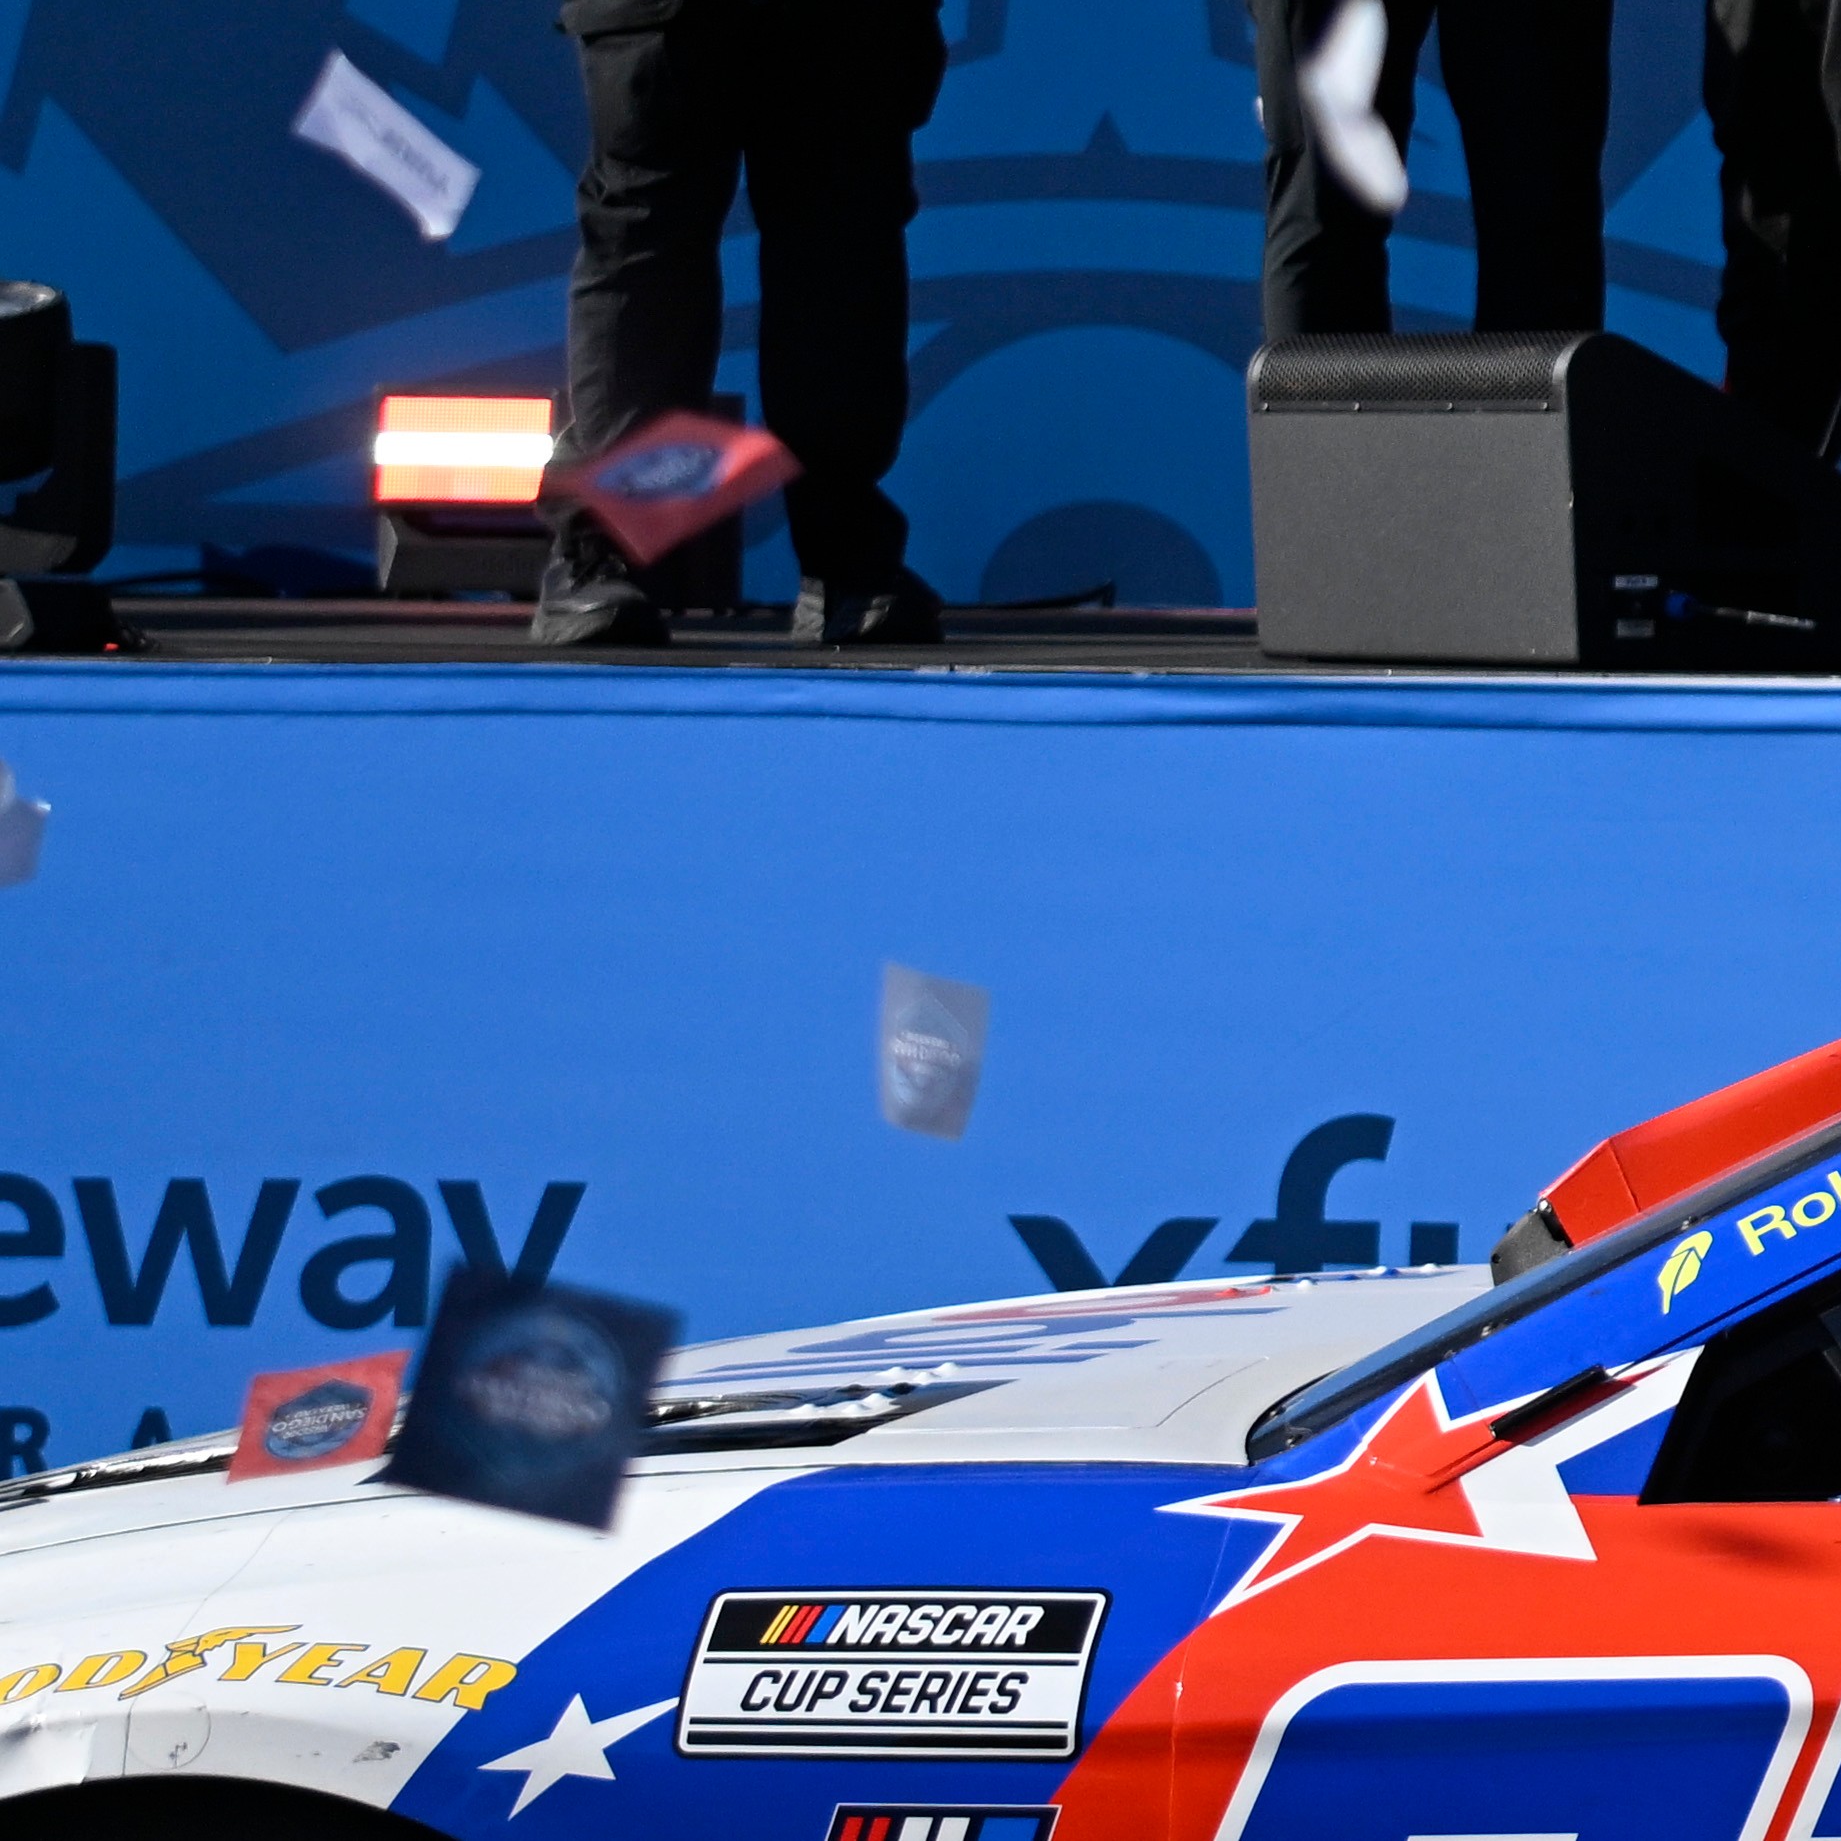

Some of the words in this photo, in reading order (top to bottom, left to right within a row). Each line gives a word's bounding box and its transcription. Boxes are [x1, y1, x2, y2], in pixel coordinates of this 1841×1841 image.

[0, 1171, 587, 1331] eway
[826, 1602, 1045, 1647] NASCAR
[0, 1638, 519, 1712] ODYEAR
[740, 1671, 849, 1715] CUP
[854, 1670, 1030, 1716] SERIES
